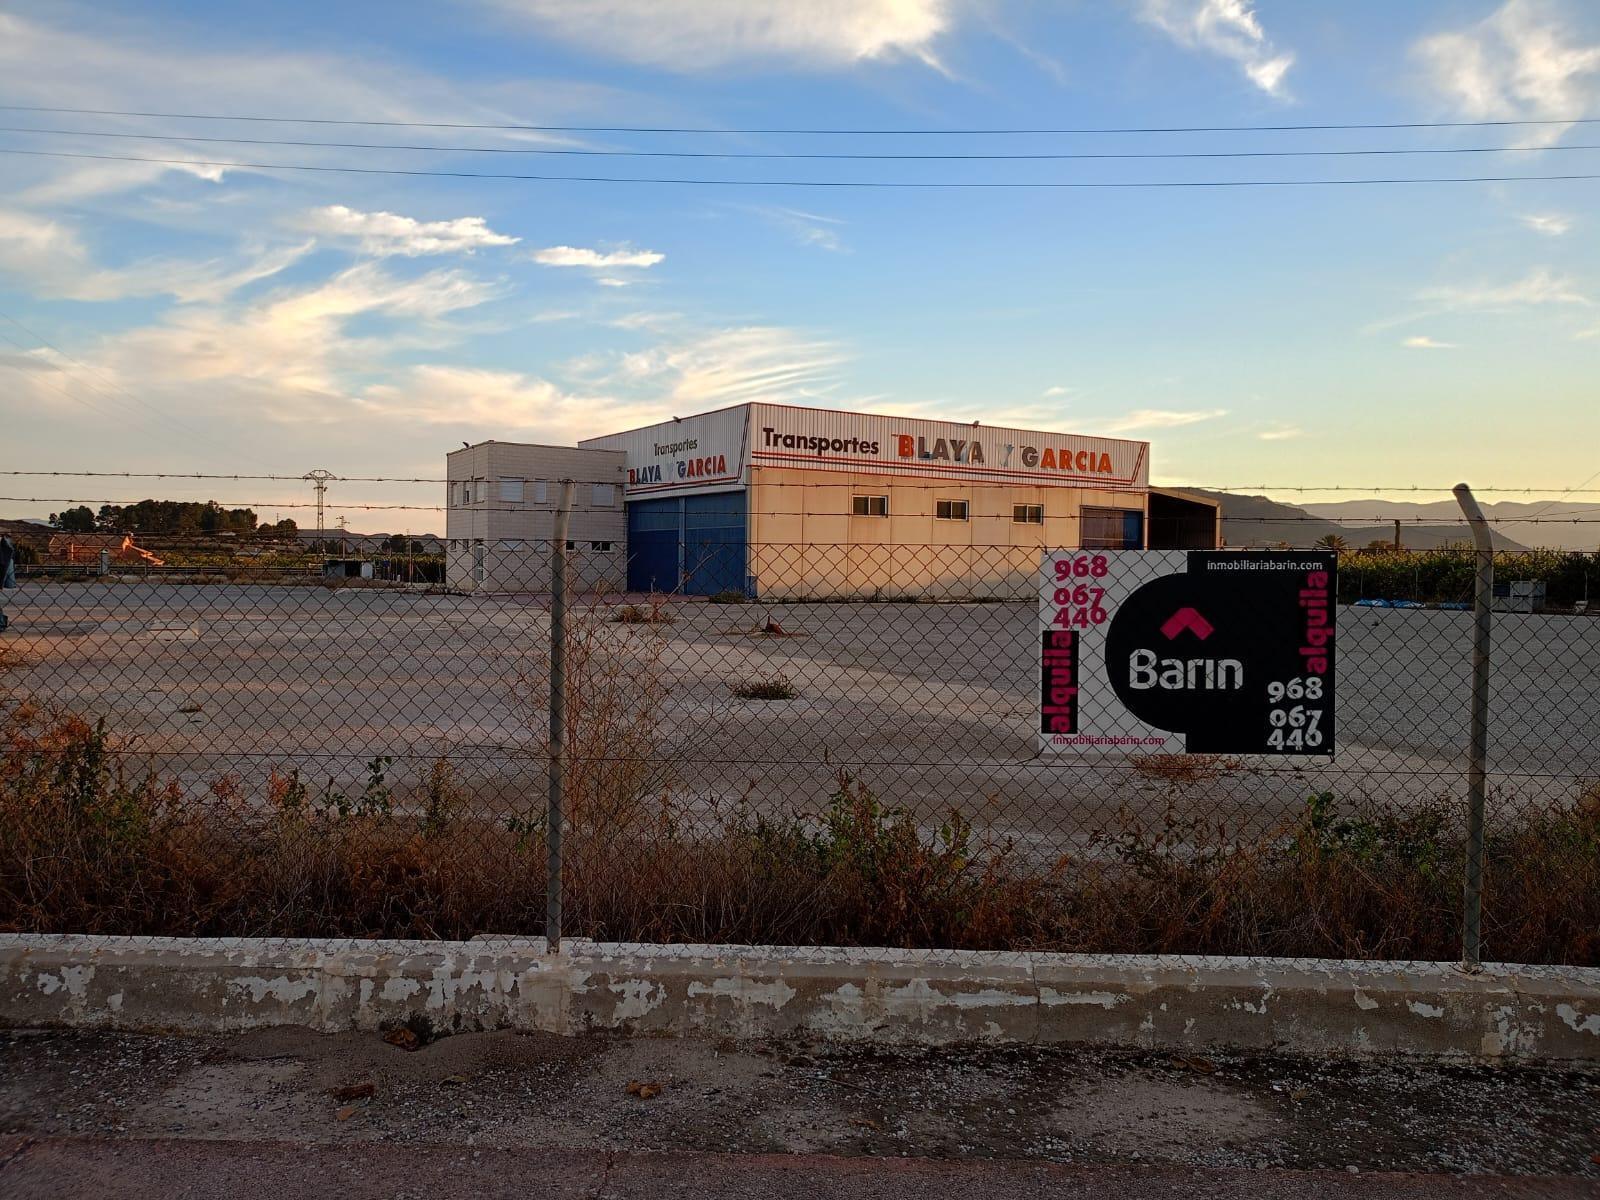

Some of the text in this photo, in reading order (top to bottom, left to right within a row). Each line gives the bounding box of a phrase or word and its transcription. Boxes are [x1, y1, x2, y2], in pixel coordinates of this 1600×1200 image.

[654, 438, 698, 457] Transportes
[763, 427, 880, 456] Transportes
[898, 434, 985, 464] BLAYA
[1021, 446, 1113, 473] GARCIA
[628, 464, 662, 486] BLAYA
[677, 455, 727, 478] GARCIA
[1054, 555, 1108, 582] 968
[1207, 559, 1323, 570] inmobiliariabarin.com
[1053, 583, 1106, 609] 067
[1299, 571, 1334, 675] alquila
[1043, 630, 1078, 734] alquila
[1267, 676, 1323, 703] 968
[1269, 705, 1323, 734] 067
[1052, 734, 1165, 745] inmobiliariabarin.com
